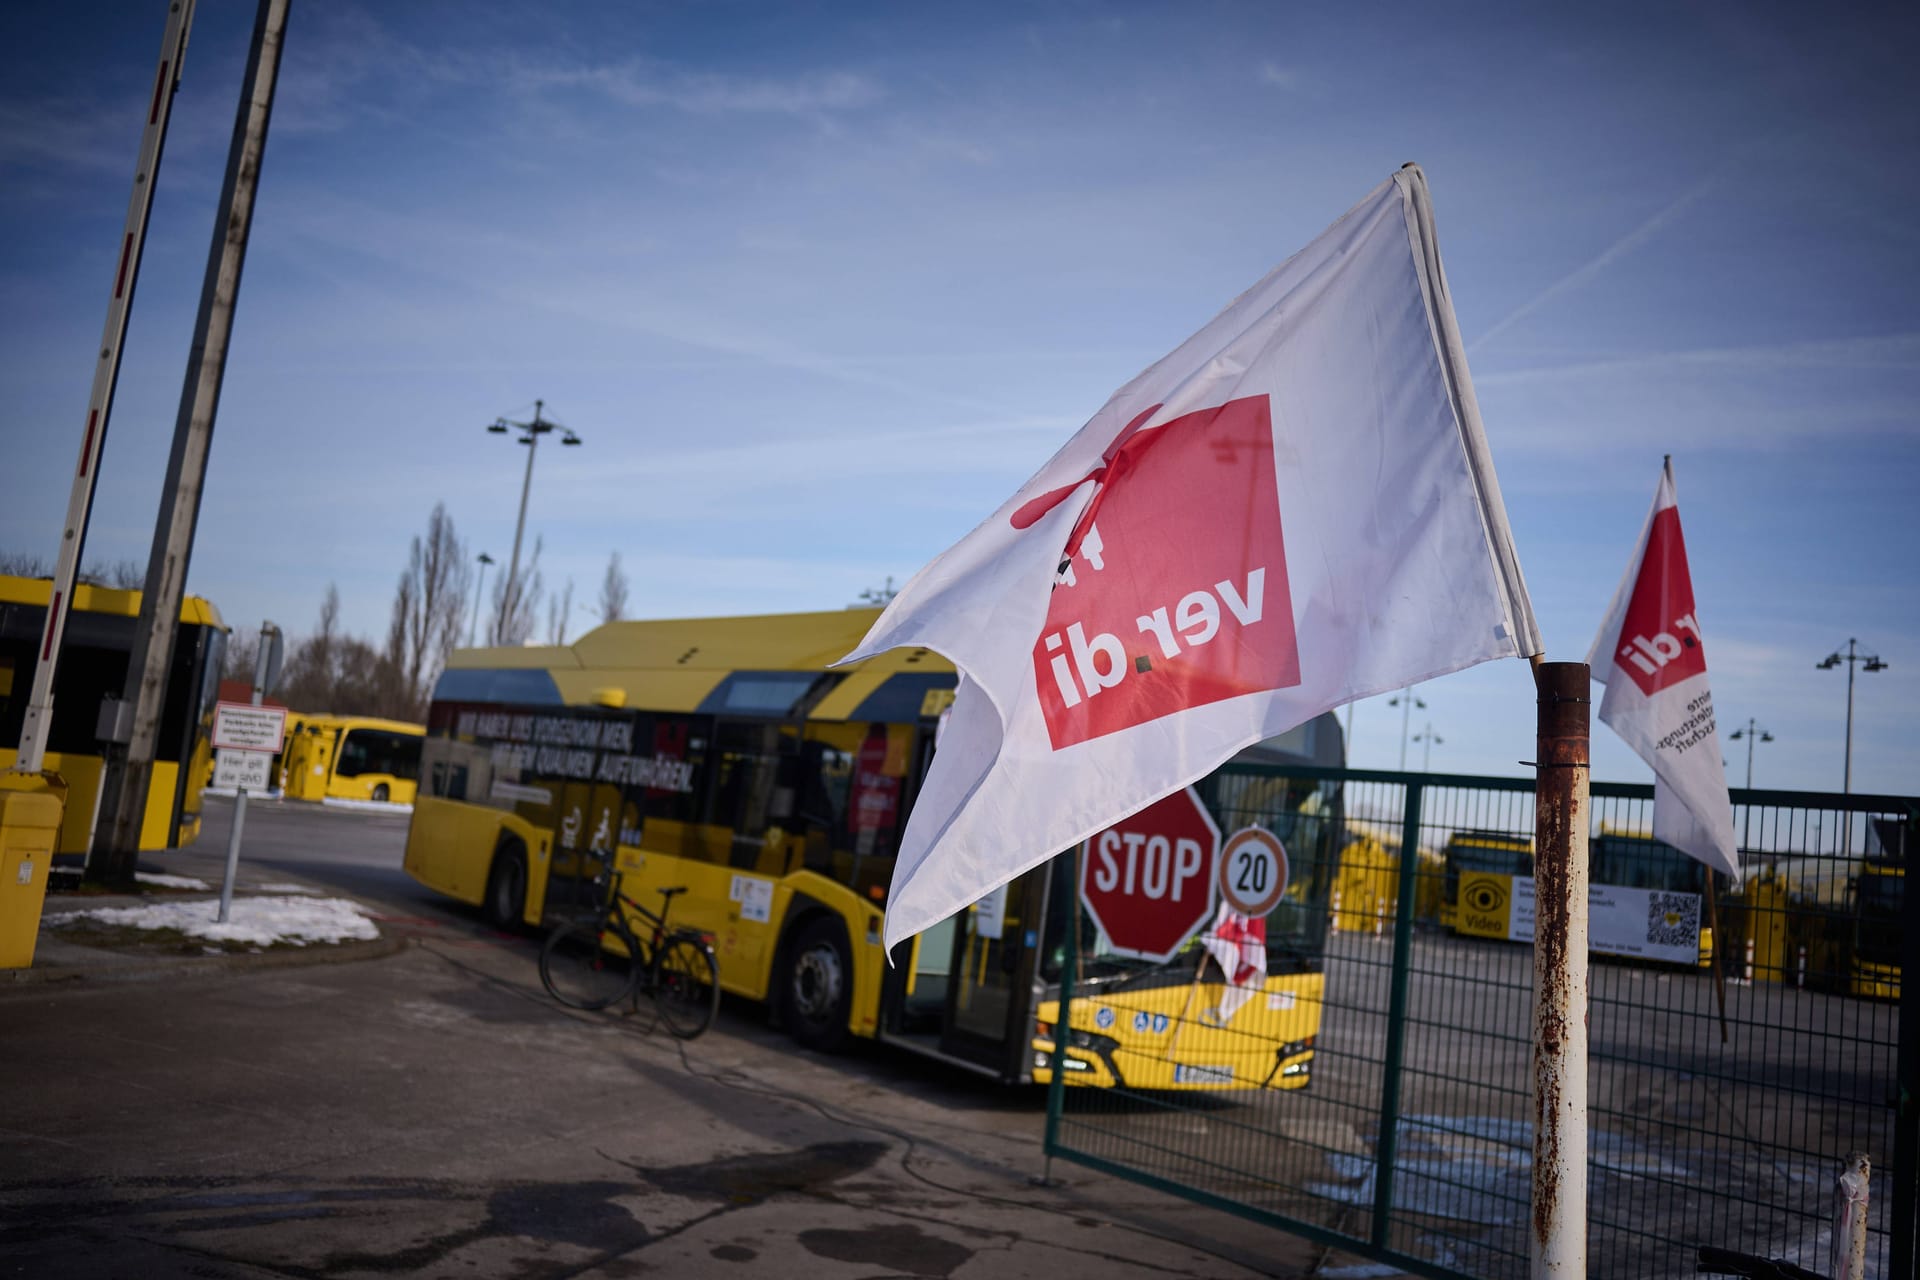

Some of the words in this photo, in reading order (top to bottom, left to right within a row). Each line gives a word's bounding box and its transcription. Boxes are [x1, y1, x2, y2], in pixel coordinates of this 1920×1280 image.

[1094, 831, 1202, 902] STOP
[1236, 852, 1269, 894] 20
[1465, 914, 1503, 932] Video
